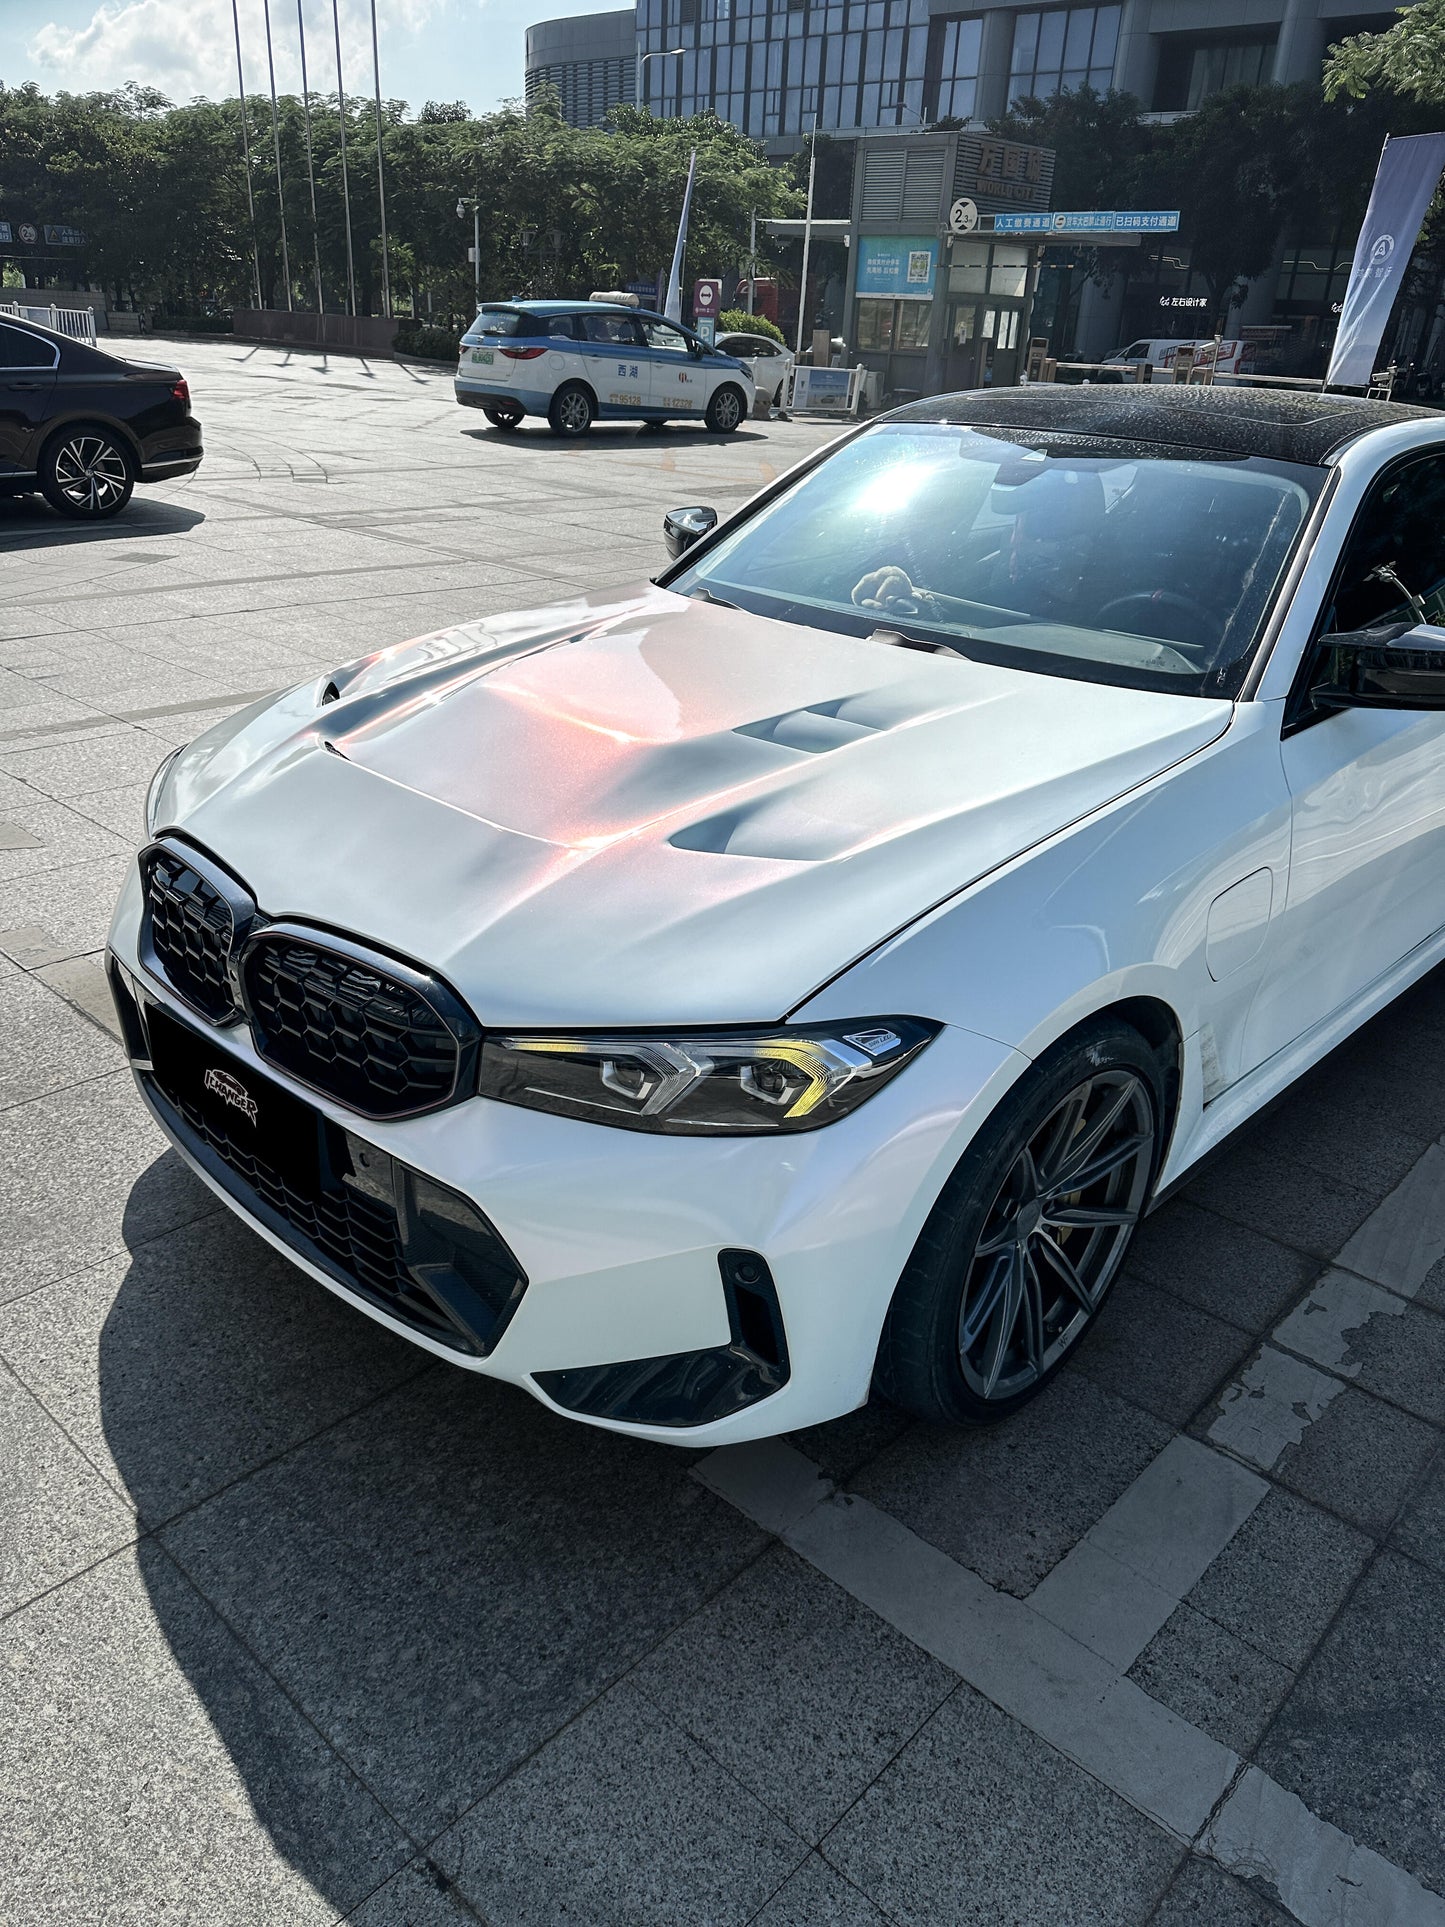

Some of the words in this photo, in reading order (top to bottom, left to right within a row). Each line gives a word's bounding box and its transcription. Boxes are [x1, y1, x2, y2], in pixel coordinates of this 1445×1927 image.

[976, 180, 1012, 199] WORLD
[996, 216, 1050, 228] 人工缴费通道
[1115, 214, 1176, 227] 已扫码支付通道
[1170, 297, 1208, 307] 左右设计家
[617, 363, 639, 378] 西湖
[619, 394, 642, 406] 95128
[672, 398, 693, 409] 12328
